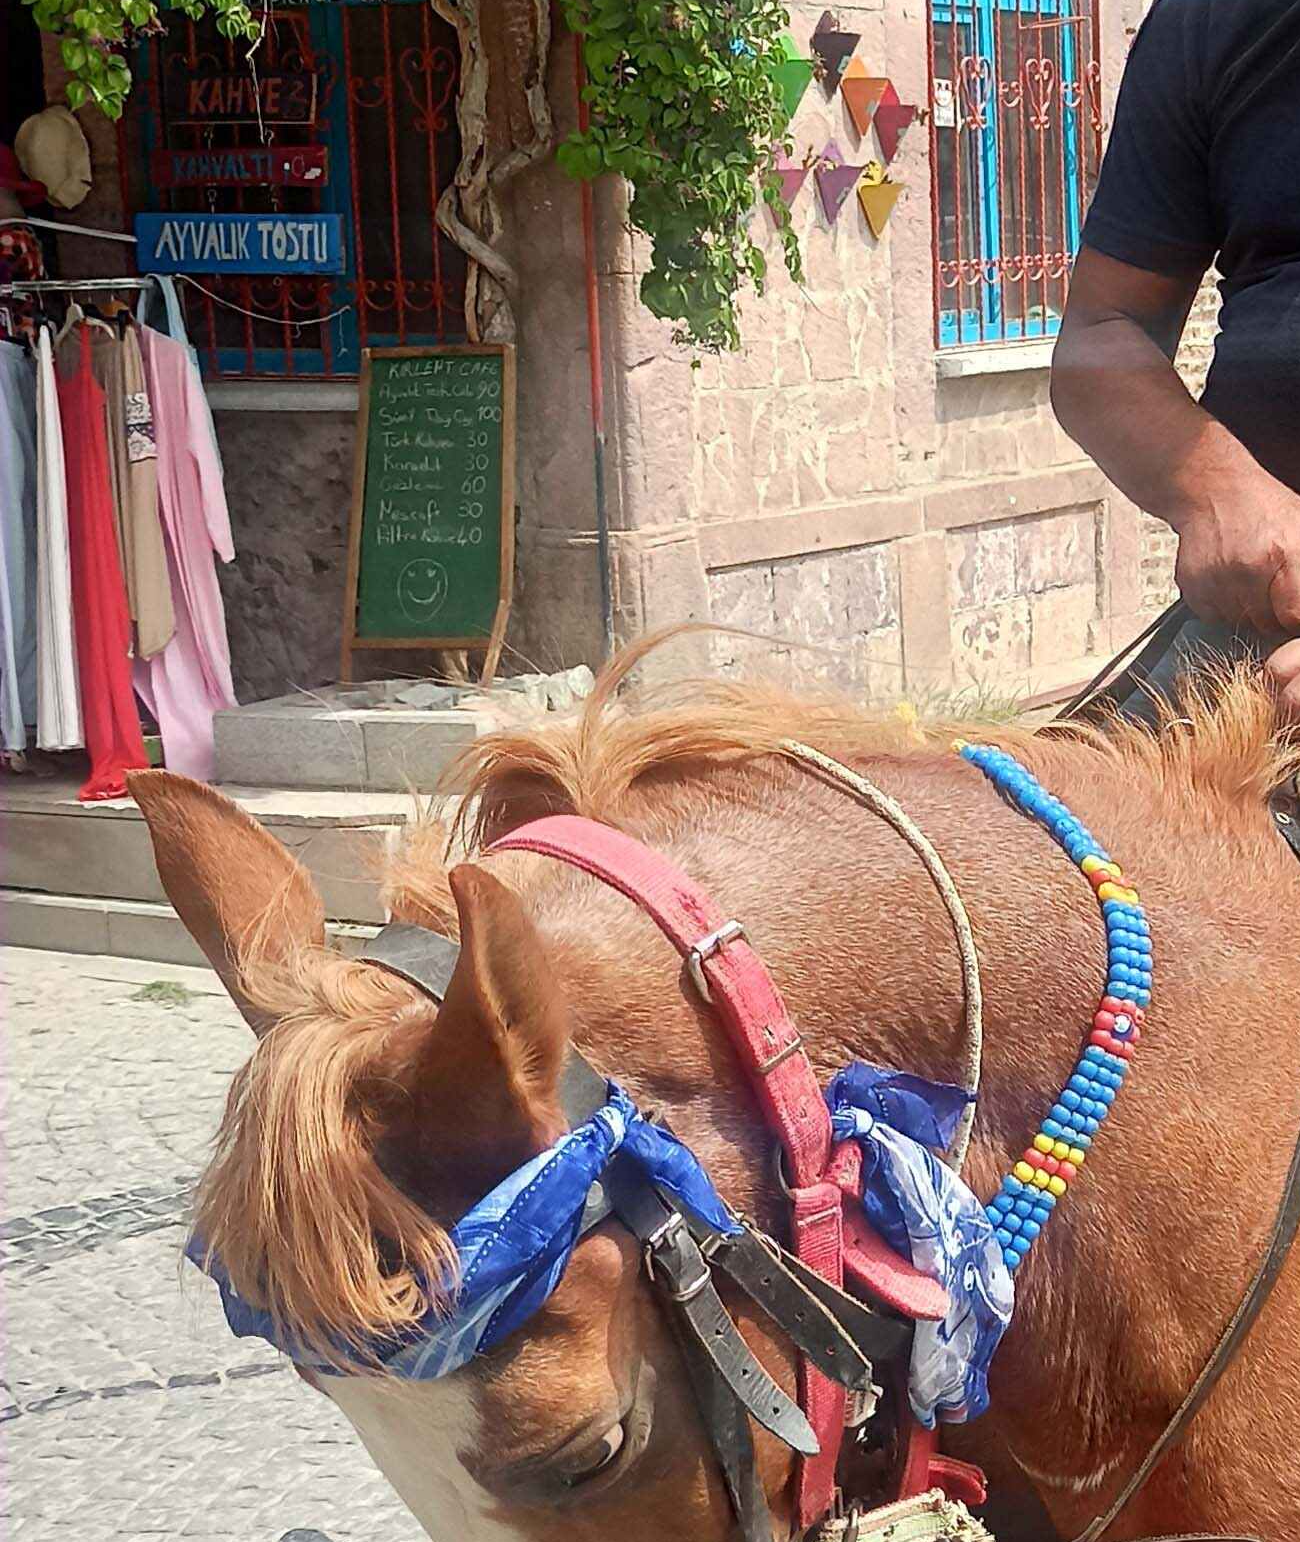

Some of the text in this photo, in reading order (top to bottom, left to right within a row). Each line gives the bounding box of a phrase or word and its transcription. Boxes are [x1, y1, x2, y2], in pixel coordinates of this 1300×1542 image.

[188, 76, 283, 116] KAHVE
[154, 220, 328, 264] AYVALIK TOSTU
[476, 380, 500, 399] 90
[477, 406, 502, 423] 100
[467, 431, 488, 447] 30
[464, 452, 489, 471] 30
[461, 475, 487, 494] 60
